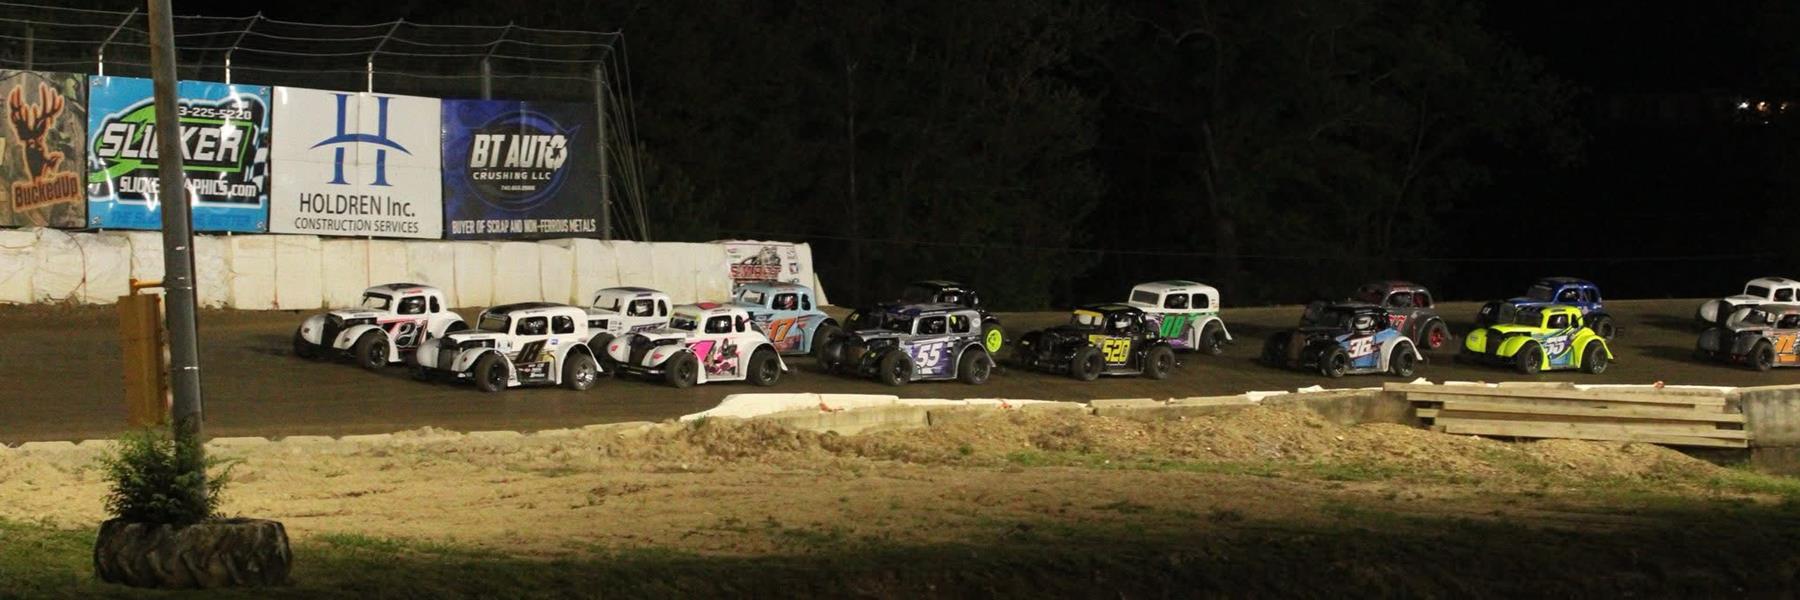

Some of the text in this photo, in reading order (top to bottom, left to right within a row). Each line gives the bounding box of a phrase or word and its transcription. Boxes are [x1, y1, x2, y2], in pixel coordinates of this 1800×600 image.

[470, 134, 569, 171] BT AUTO
[119, 176, 257, 197] SLICKEAPHICS.com
[473, 172, 552, 180] CRUSHING LLC
[300, 193, 416, 217] HOLDREN Inc.
[294, 217, 419, 233] CONSTRUCTION SERVICES
[452, 220, 475, 234] BUYER
[476, 220, 485, 233] OF
[487, 220, 509, 234] SCRAP
[510, 219, 523, 233] AND
[569, 219, 596, 232] METALS
[915, 342, 944, 368] 55
[1102, 337, 1132, 362] 520
